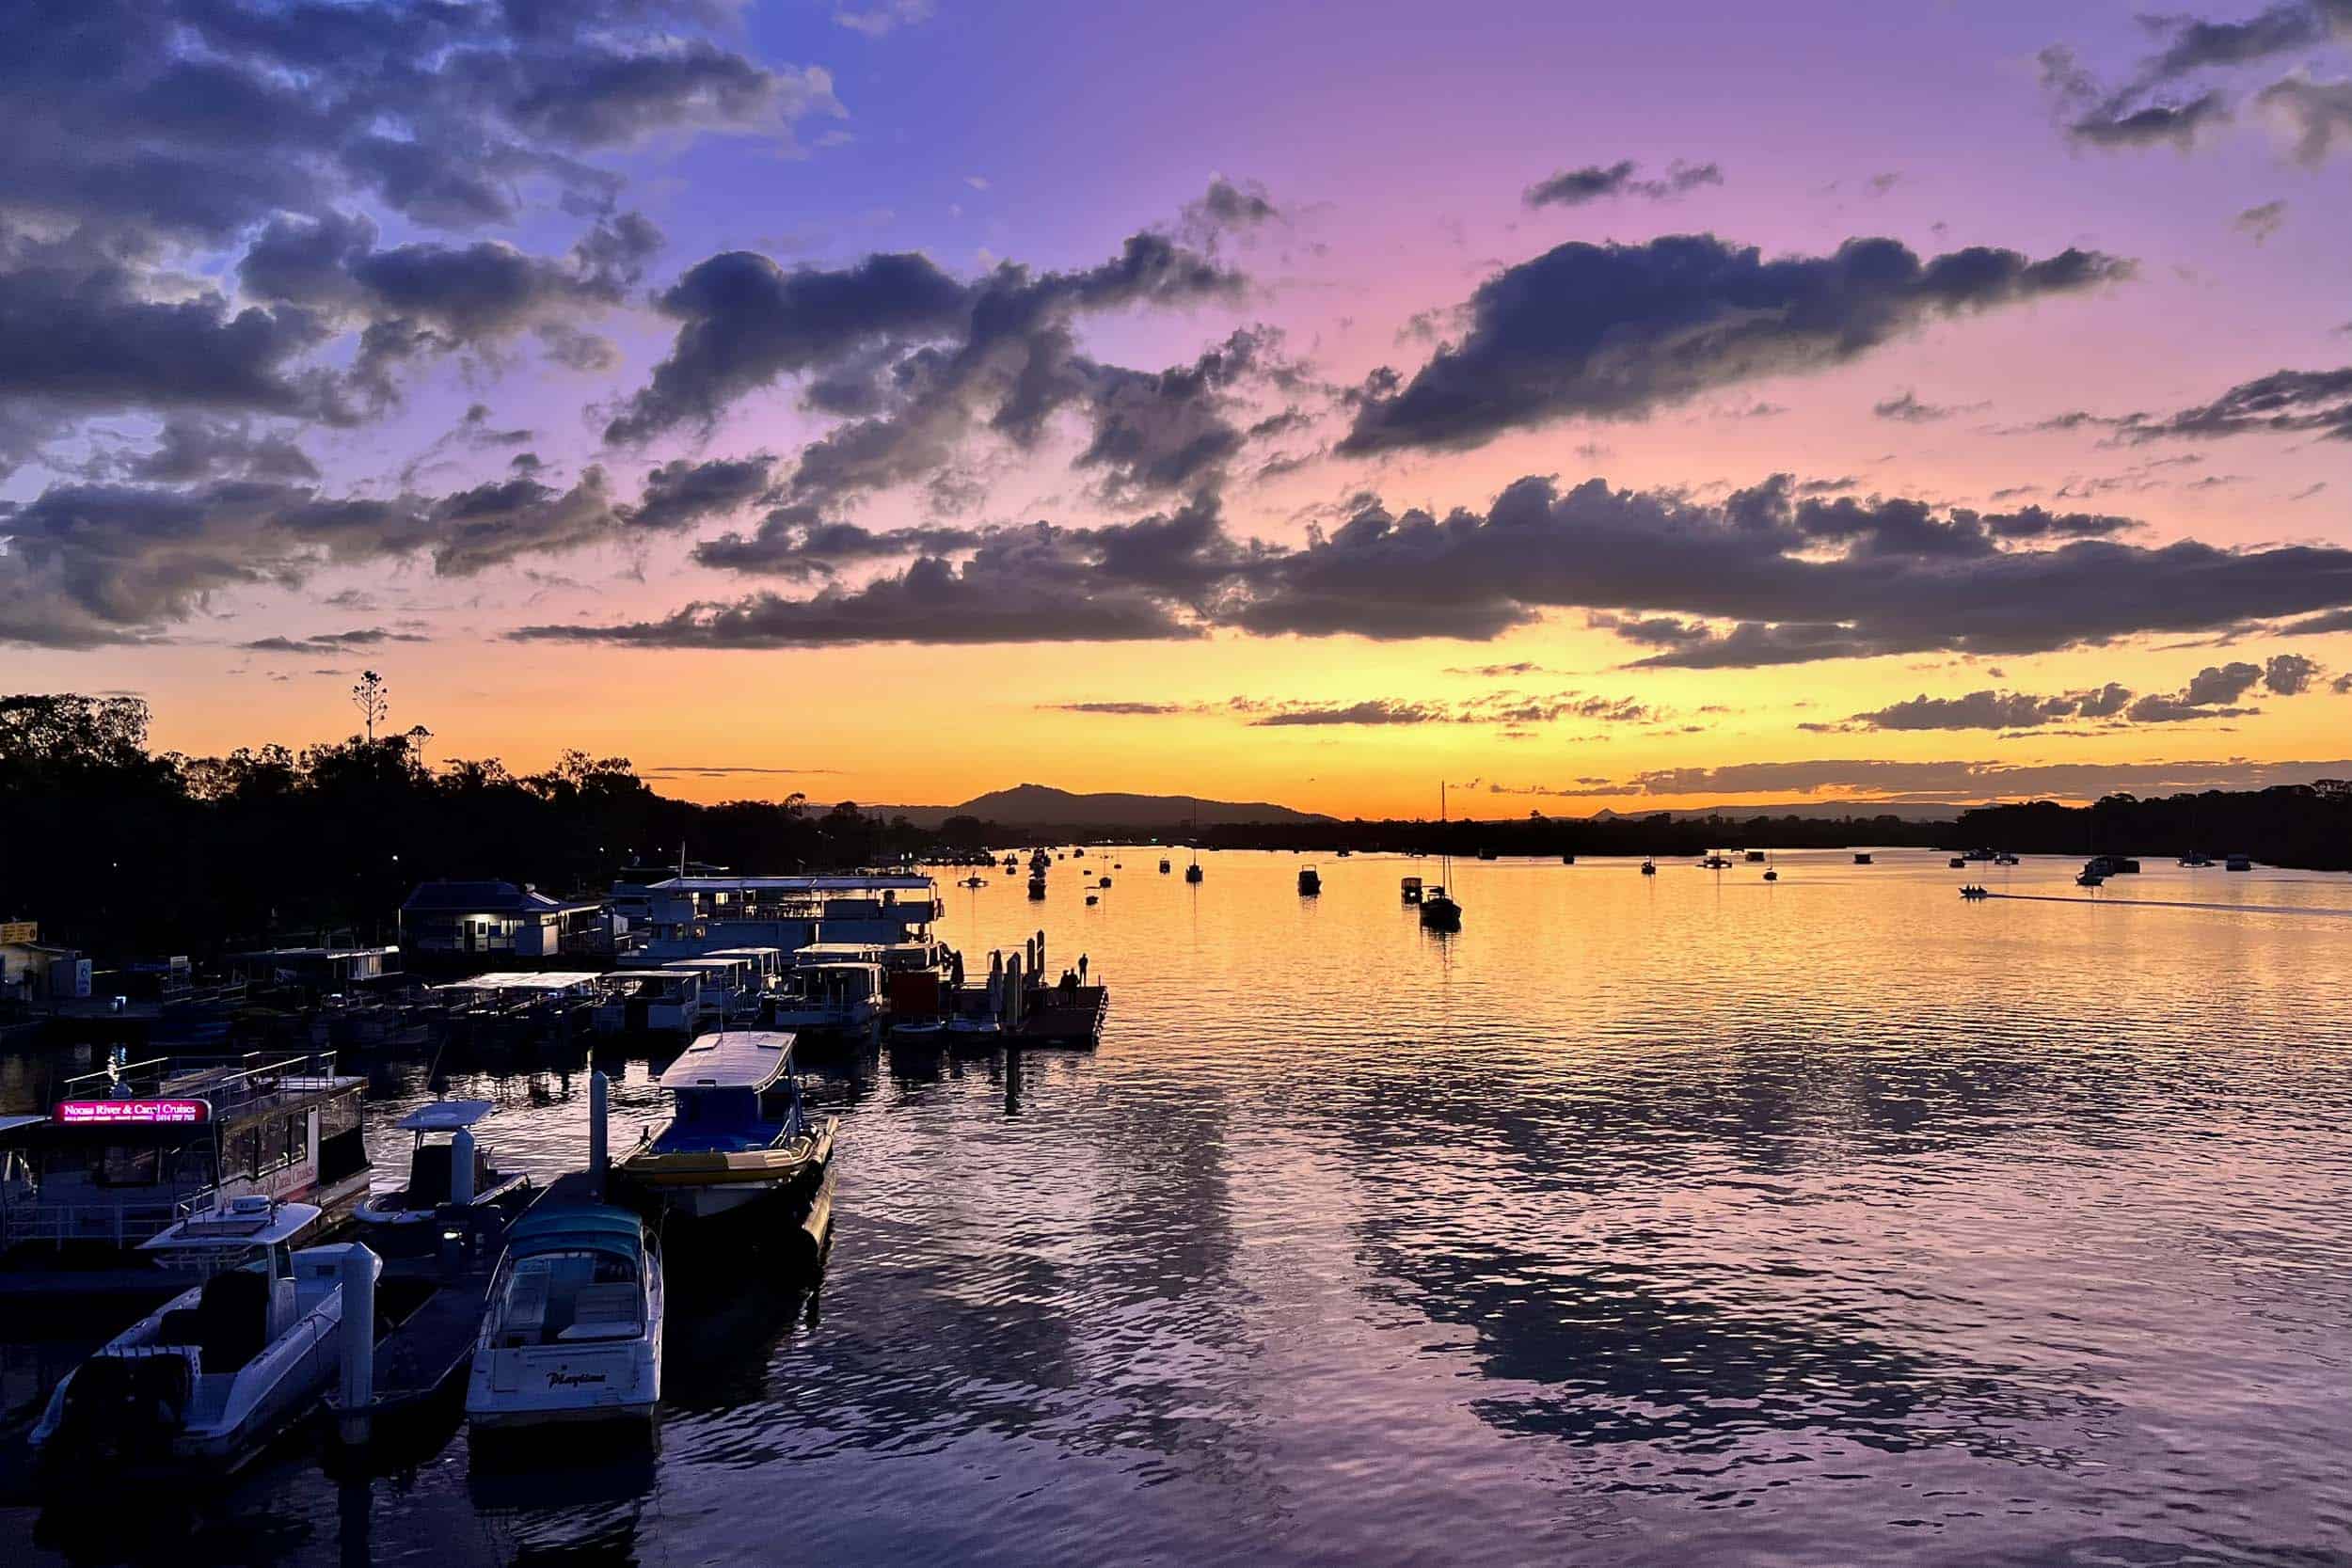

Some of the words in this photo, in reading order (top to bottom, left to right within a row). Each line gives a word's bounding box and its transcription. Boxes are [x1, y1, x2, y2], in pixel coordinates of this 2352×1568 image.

[96, 1105, 121, 1115] River
[122, 1105, 133, 1115] &
[163, 1104, 196, 1114] Cruises
